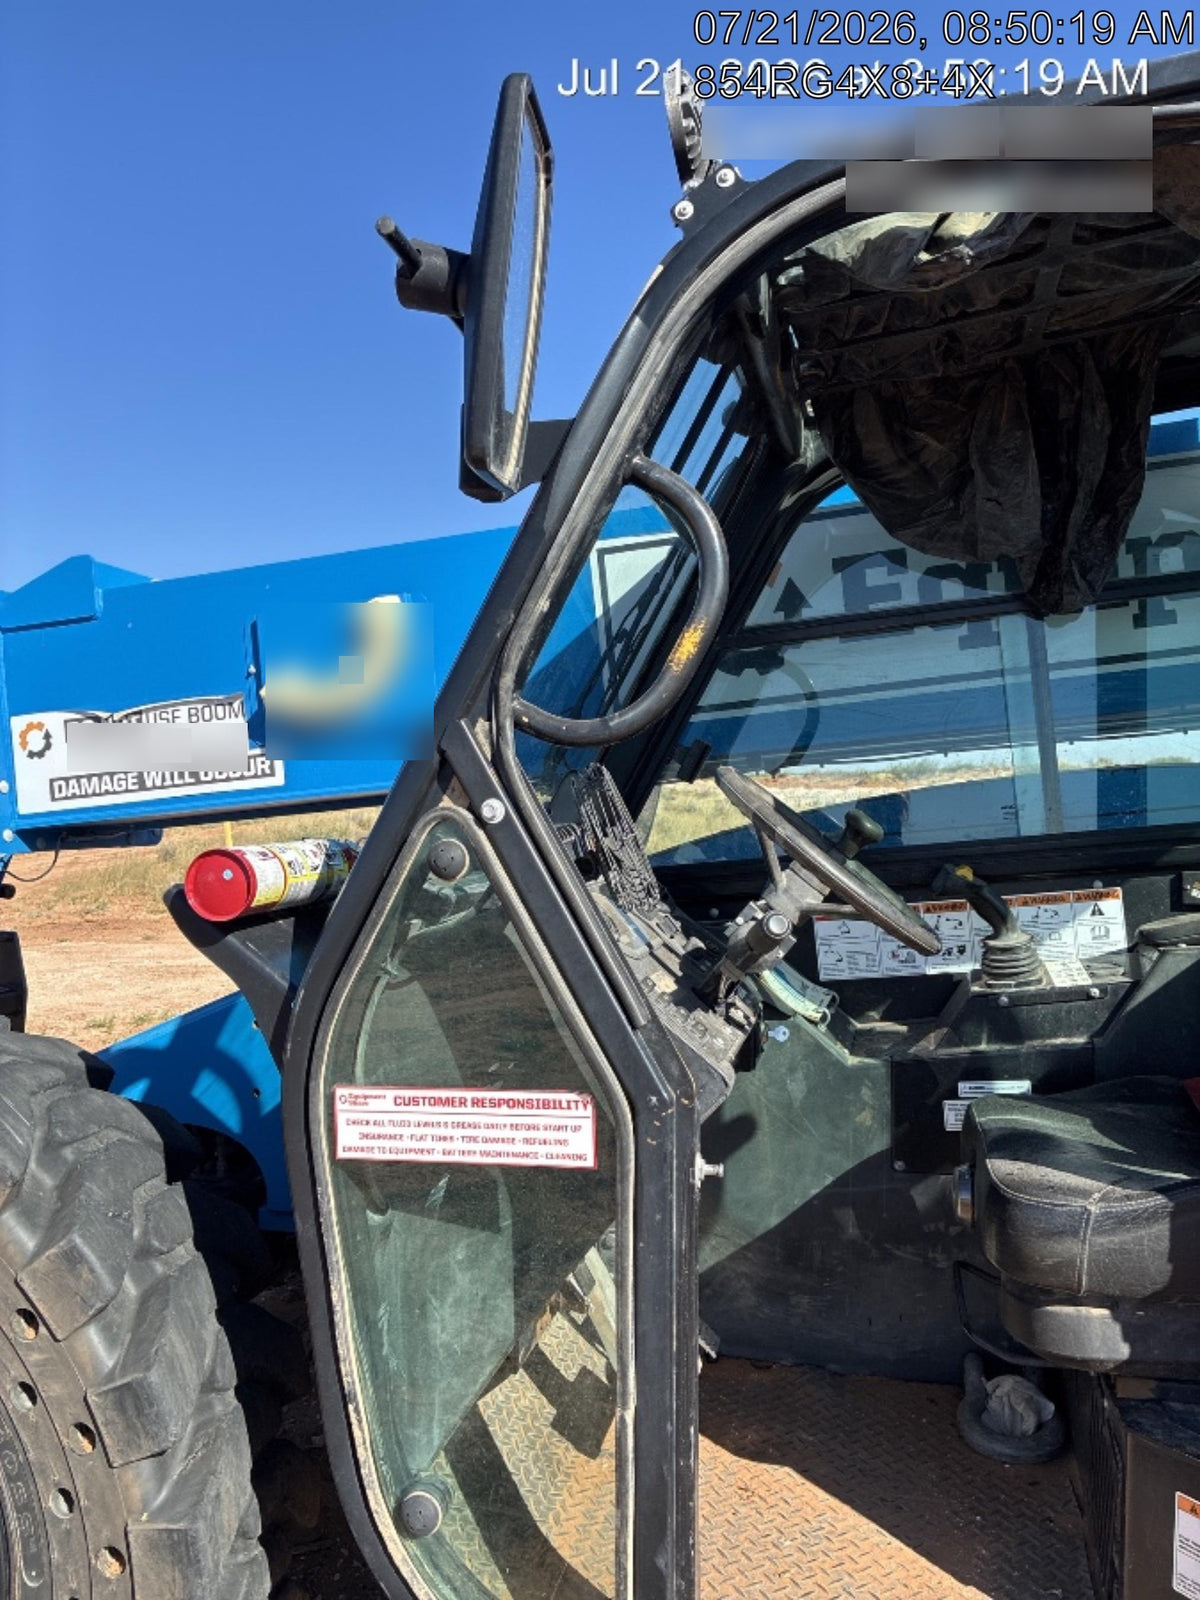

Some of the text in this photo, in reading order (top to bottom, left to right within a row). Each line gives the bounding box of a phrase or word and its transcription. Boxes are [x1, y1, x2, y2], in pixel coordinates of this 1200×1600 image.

[188, 701, 245, 724] BOOM
[53, 771, 138, 799] DAMAGE
[143, 771, 196, 789] WILL
[393, 1096, 589, 1112] CUSTOMER RESPONSIBILITY
[373, 1119, 385, 1127] ALL
[509, 1123, 541, 1132] BEFORE
[542, 1124, 568, 1133] START
[570, 1125, 582, 1133] UP
[410, 1133, 429, 1141] FLAT
[481, 1136, 516, 1145] DAMAGE
[377, 1146, 388, 1154] TO
[389, 1147, 436, 1156] EQUIPMENT
[479, 1150, 539, 1159] MAINTENANCE
[545, 1152, 588, 1162] CLEANING
